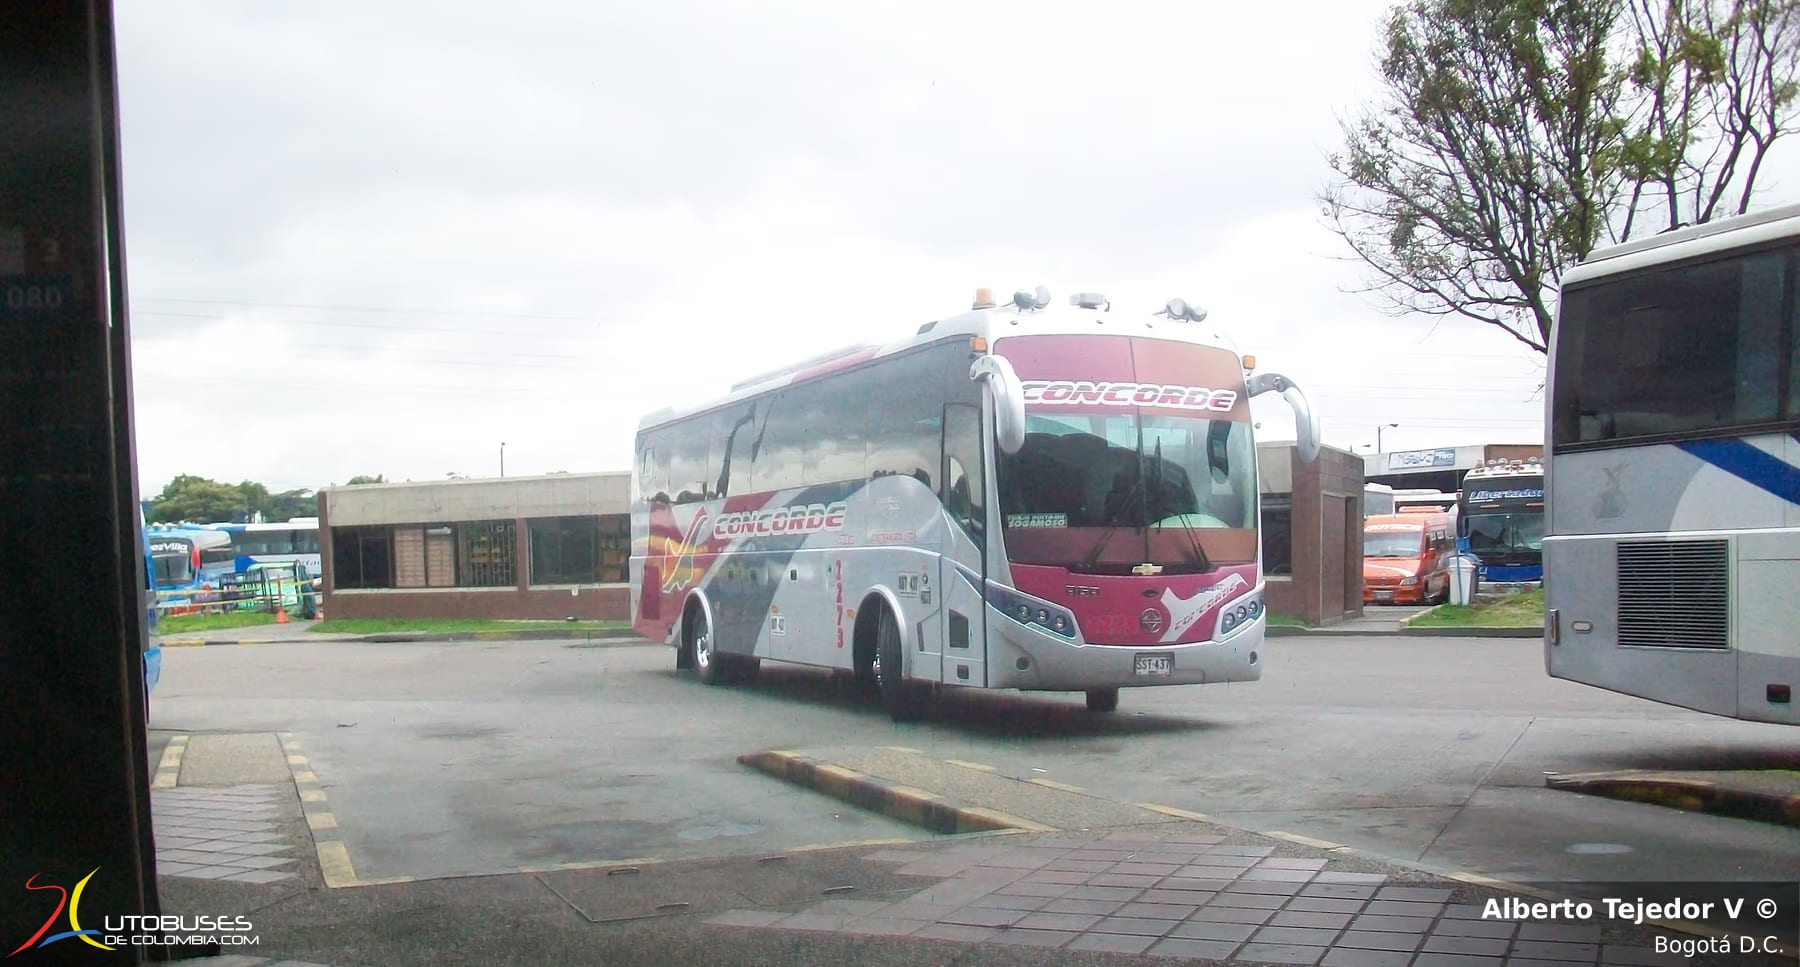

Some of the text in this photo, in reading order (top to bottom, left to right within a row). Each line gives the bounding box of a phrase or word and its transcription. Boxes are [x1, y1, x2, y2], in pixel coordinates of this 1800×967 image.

[1021, 381, 1238, 412] CONCORDE
[714, 503, 847, 538] CONCORDE
[835, 559, 845, 649] 2273
